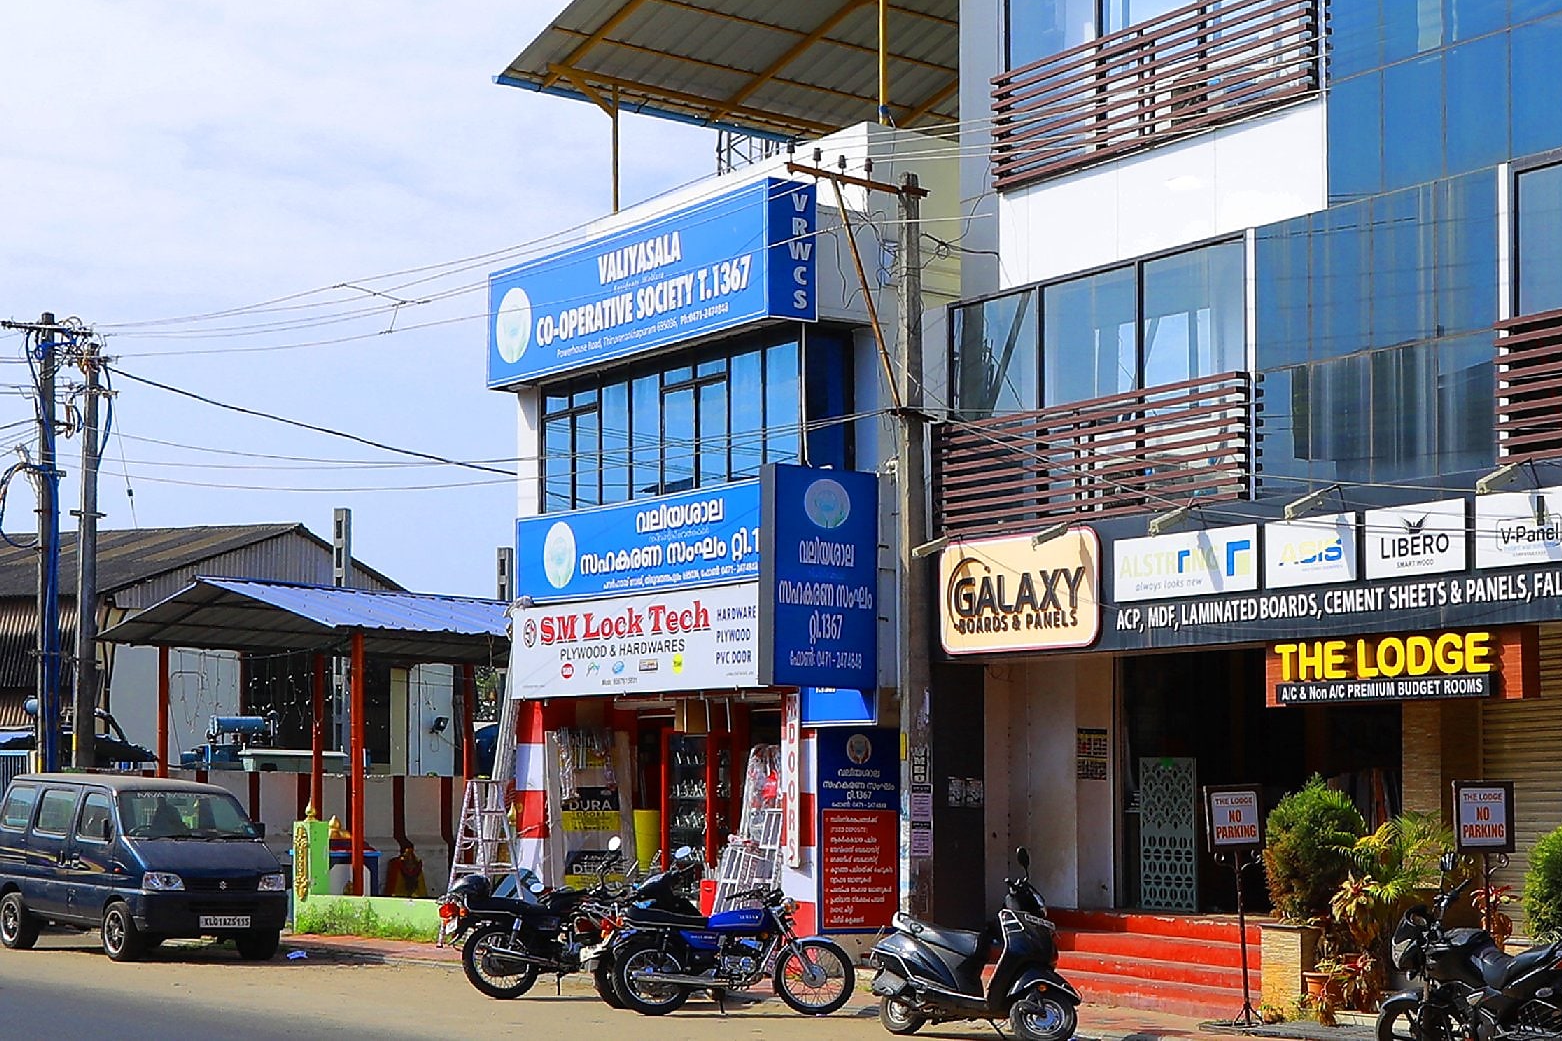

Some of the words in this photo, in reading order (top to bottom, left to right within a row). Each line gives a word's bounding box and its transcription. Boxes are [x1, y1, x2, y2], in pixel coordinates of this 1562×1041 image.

[597, 230, 683, 286] VALIYASALA
[535, 291, 634, 348] CO-OPERATIVE
[636, 272, 695, 320] SOCIETY
[697, 253, 752, 302] T.1367
[635, 497, 724, 535] വലിയശാല
[1501, 522, 1560, 545] V-Panel
[580, 542, 663, 575] സഹകരണ
[666, 537, 727, 565] സംഘം
[799, 535, 855, 568] വലിയശാല
[1380, 532, 1450, 560] LIBERO
[778, 579, 834, 608] സഹകരണ
[836, 585, 873, 610] സംഘം
[953, 565, 1087, 619] GALAXY
[1135, 579, 1162, 592] always
[1164, 578, 1184, 590] looks
[1186, 579, 1202, 587] new
[716, 604, 757, 623] HARDWARE
[1116, 607, 1145, 633] ACP,
[1147, 606, 1180, 632] MDF,
[1181, 597, 1258, 625] LAMINATED
[1259, 592, 1323, 620] BOARDS,
[1324, 587, 1386, 615] CEMENT
[1388, 581, 1448, 610] SHEETS
[1450, 580, 1463, 605] &
[540, 614, 577, 646] SM
[582, 607, 645, 642] Lock
[648, 600, 712, 636] Tech
[957, 614, 1009, 635] BOARDS
[1011, 614, 1022, 631] &
[1025, 608, 1079, 630] PANELS
[715, 628, 751, 644] PLYWOOD
[560, 645, 608, 661] PLYWOOD
[609, 645, 617, 657] &
[619, 638, 686, 656] HARDWARES
[715, 651, 730, 665] PVC
[731, 649, 752, 664] DOOR
[1274, 640, 1348, 682] THE
[1356, 632, 1493, 678] LODGE
[1281, 686, 1298, 701] A/C
[1299, 686, 1307, 700] &
[1308, 685, 1328, 700] Non
[1328, 683, 1345, 699] A/C
[1347, 682, 1395, 698] PREMIUM
[1397, 680, 1441, 696] BUDGET
[1443, 677, 1484, 694] ROOMS
[569, 799, 613, 811] DURA
[1230, 797, 1253, 805] LODGE
[1463, 793, 1478, 801] THE
[1478, 792, 1503, 801] LODGE
[1228, 809, 1242, 823] NO
[1476, 806, 1490, 821] NO
[1215, 824, 1257, 839] PARKING
[1462, 823, 1505, 839] PARKING
